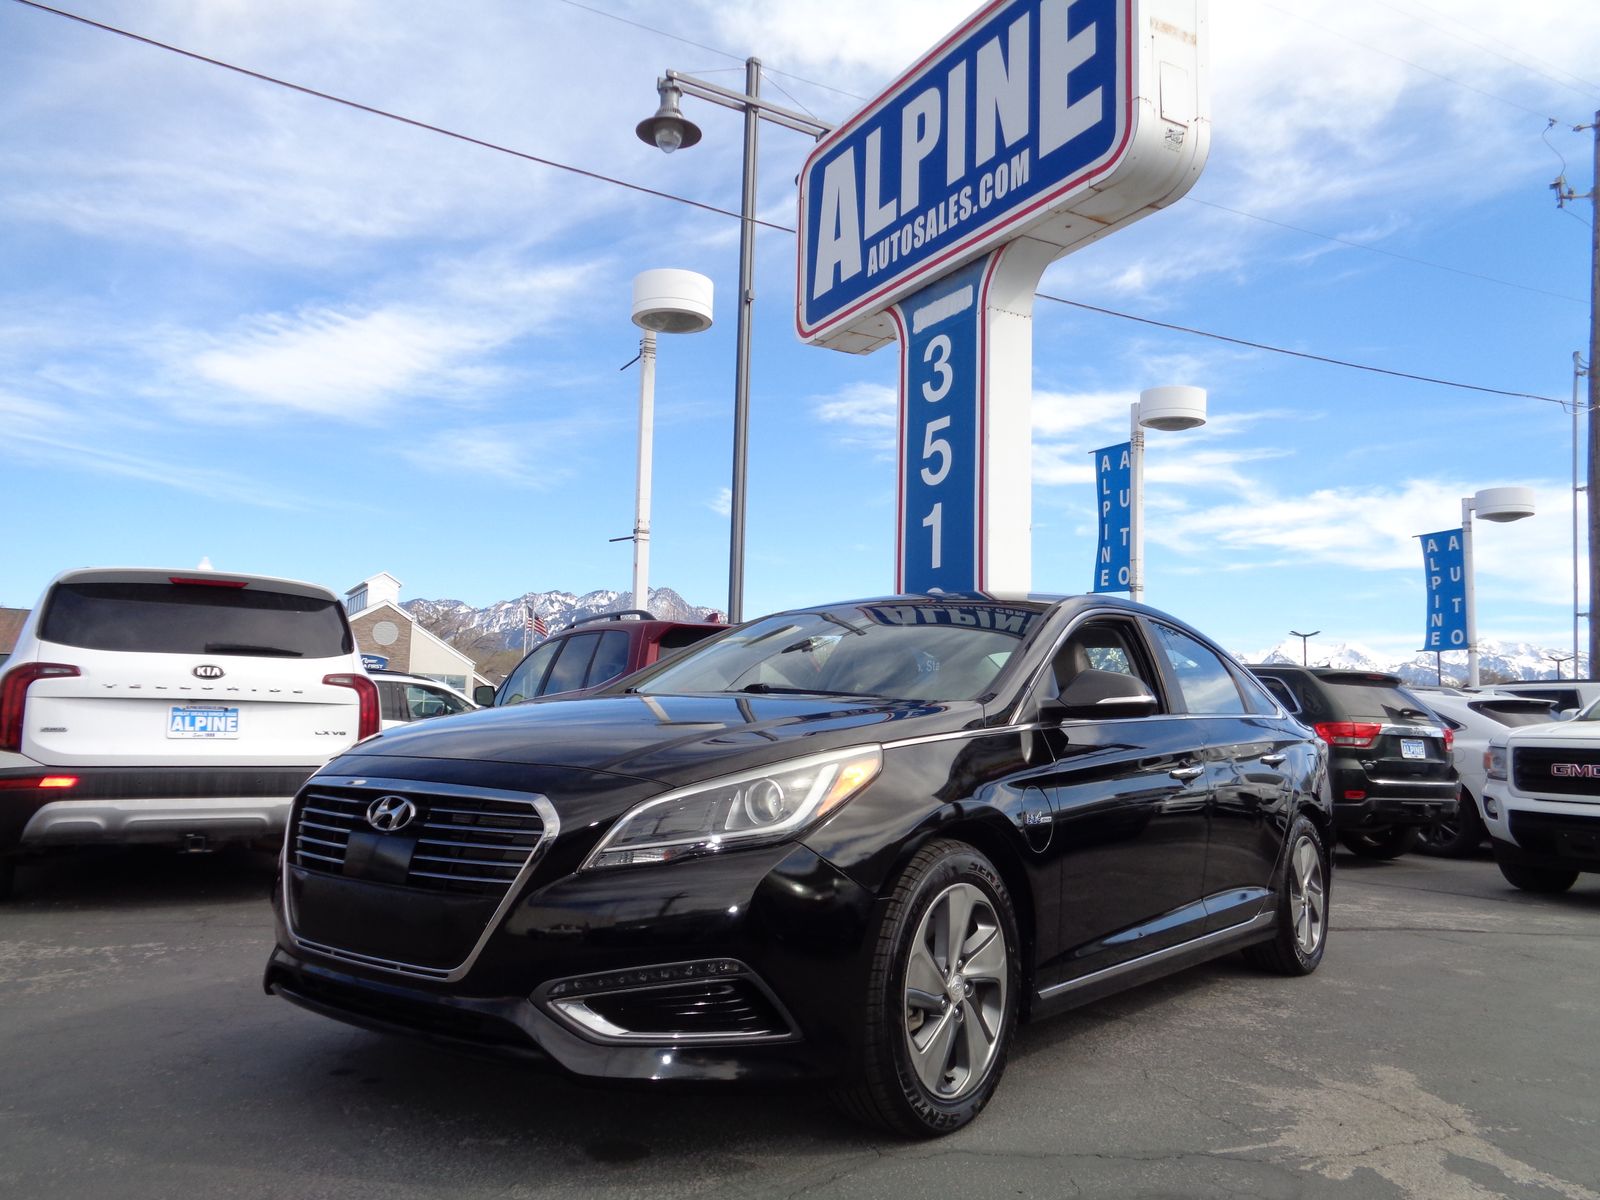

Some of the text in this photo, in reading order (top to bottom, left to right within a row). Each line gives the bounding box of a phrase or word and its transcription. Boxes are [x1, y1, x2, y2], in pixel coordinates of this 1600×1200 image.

[813, 0, 1103, 299] ALPINE
[867, 148, 1030, 278] AUTOSALES.COM
[920, 334, 953, 595] 351
[1101, 455, 1111, 586] ALPINE
[1118, 450, 1130, 585] AUTO
[1426, 539, 1443, 646] ALPINE
[1448, 535, 1464, 645] AUTO
[171, 716, 237, 732] ALPINE
[196, 667, 221, 677] KIA
